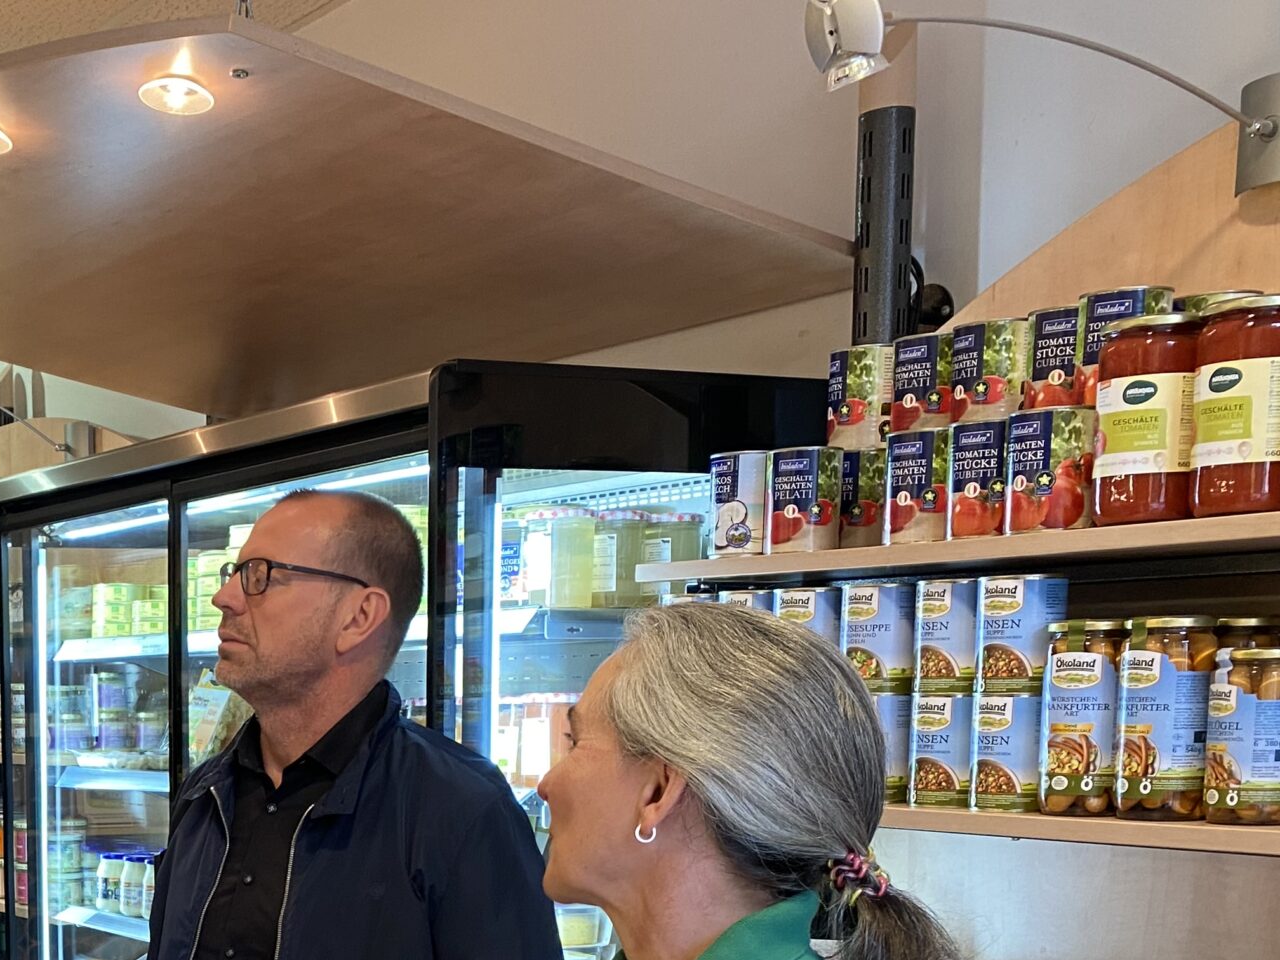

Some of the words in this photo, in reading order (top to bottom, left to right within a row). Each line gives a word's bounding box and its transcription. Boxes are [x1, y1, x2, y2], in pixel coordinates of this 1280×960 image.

[1037, 336, 1076, 348] TOMATE
[1036, 346, 1075, 359] STÜCK
[895, 362, 931, 373] GESCHÄLTE
[895, 369, 931, 380] TOMATEN
[895, 377, 931, 391] PELATI
[1201, 404, 1244, 416] GESCHÄLTE
[1112, 416, 1159, 426] GESCHÄLTE
[954, 449, 999, 460] TOMATEN
[953, 458, 998, 471] STÜCKE
[774, 474, 813, 483] GESCHÄLTE
[953, 469, 998, 481] CUBETTI
[774, 482, 813, 491] TOMATEN
[774, 490, 813, 500] PELATI
[1055, 657, 1097, 669] Ökoland
